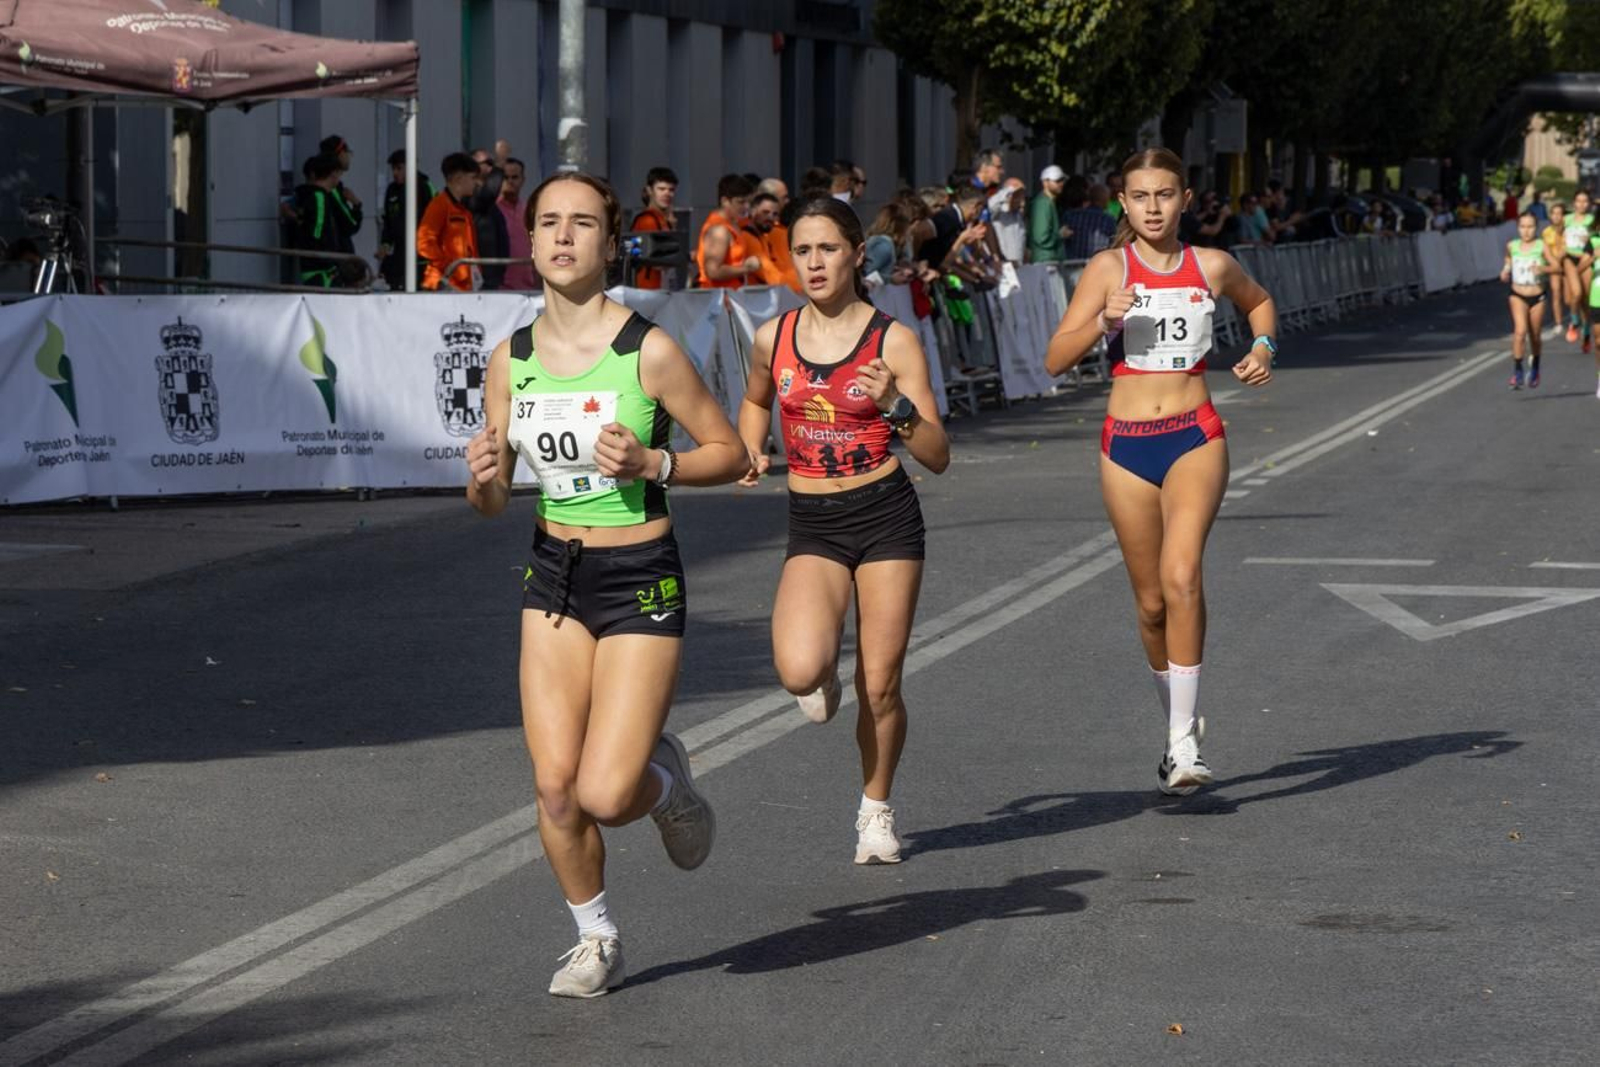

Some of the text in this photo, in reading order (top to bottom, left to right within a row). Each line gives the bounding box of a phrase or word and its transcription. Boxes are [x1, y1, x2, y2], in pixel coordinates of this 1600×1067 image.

[1154, 317, 1188, 342] 13
[517, 401, 536, 420] 37
[1112, 411, 1198, 434] ANTORCHA
[372, 429, 386, 442] de
[150, 447, 246, 468] CIUDAD DE JAÉN
[537, 431, 580, 463] 90
